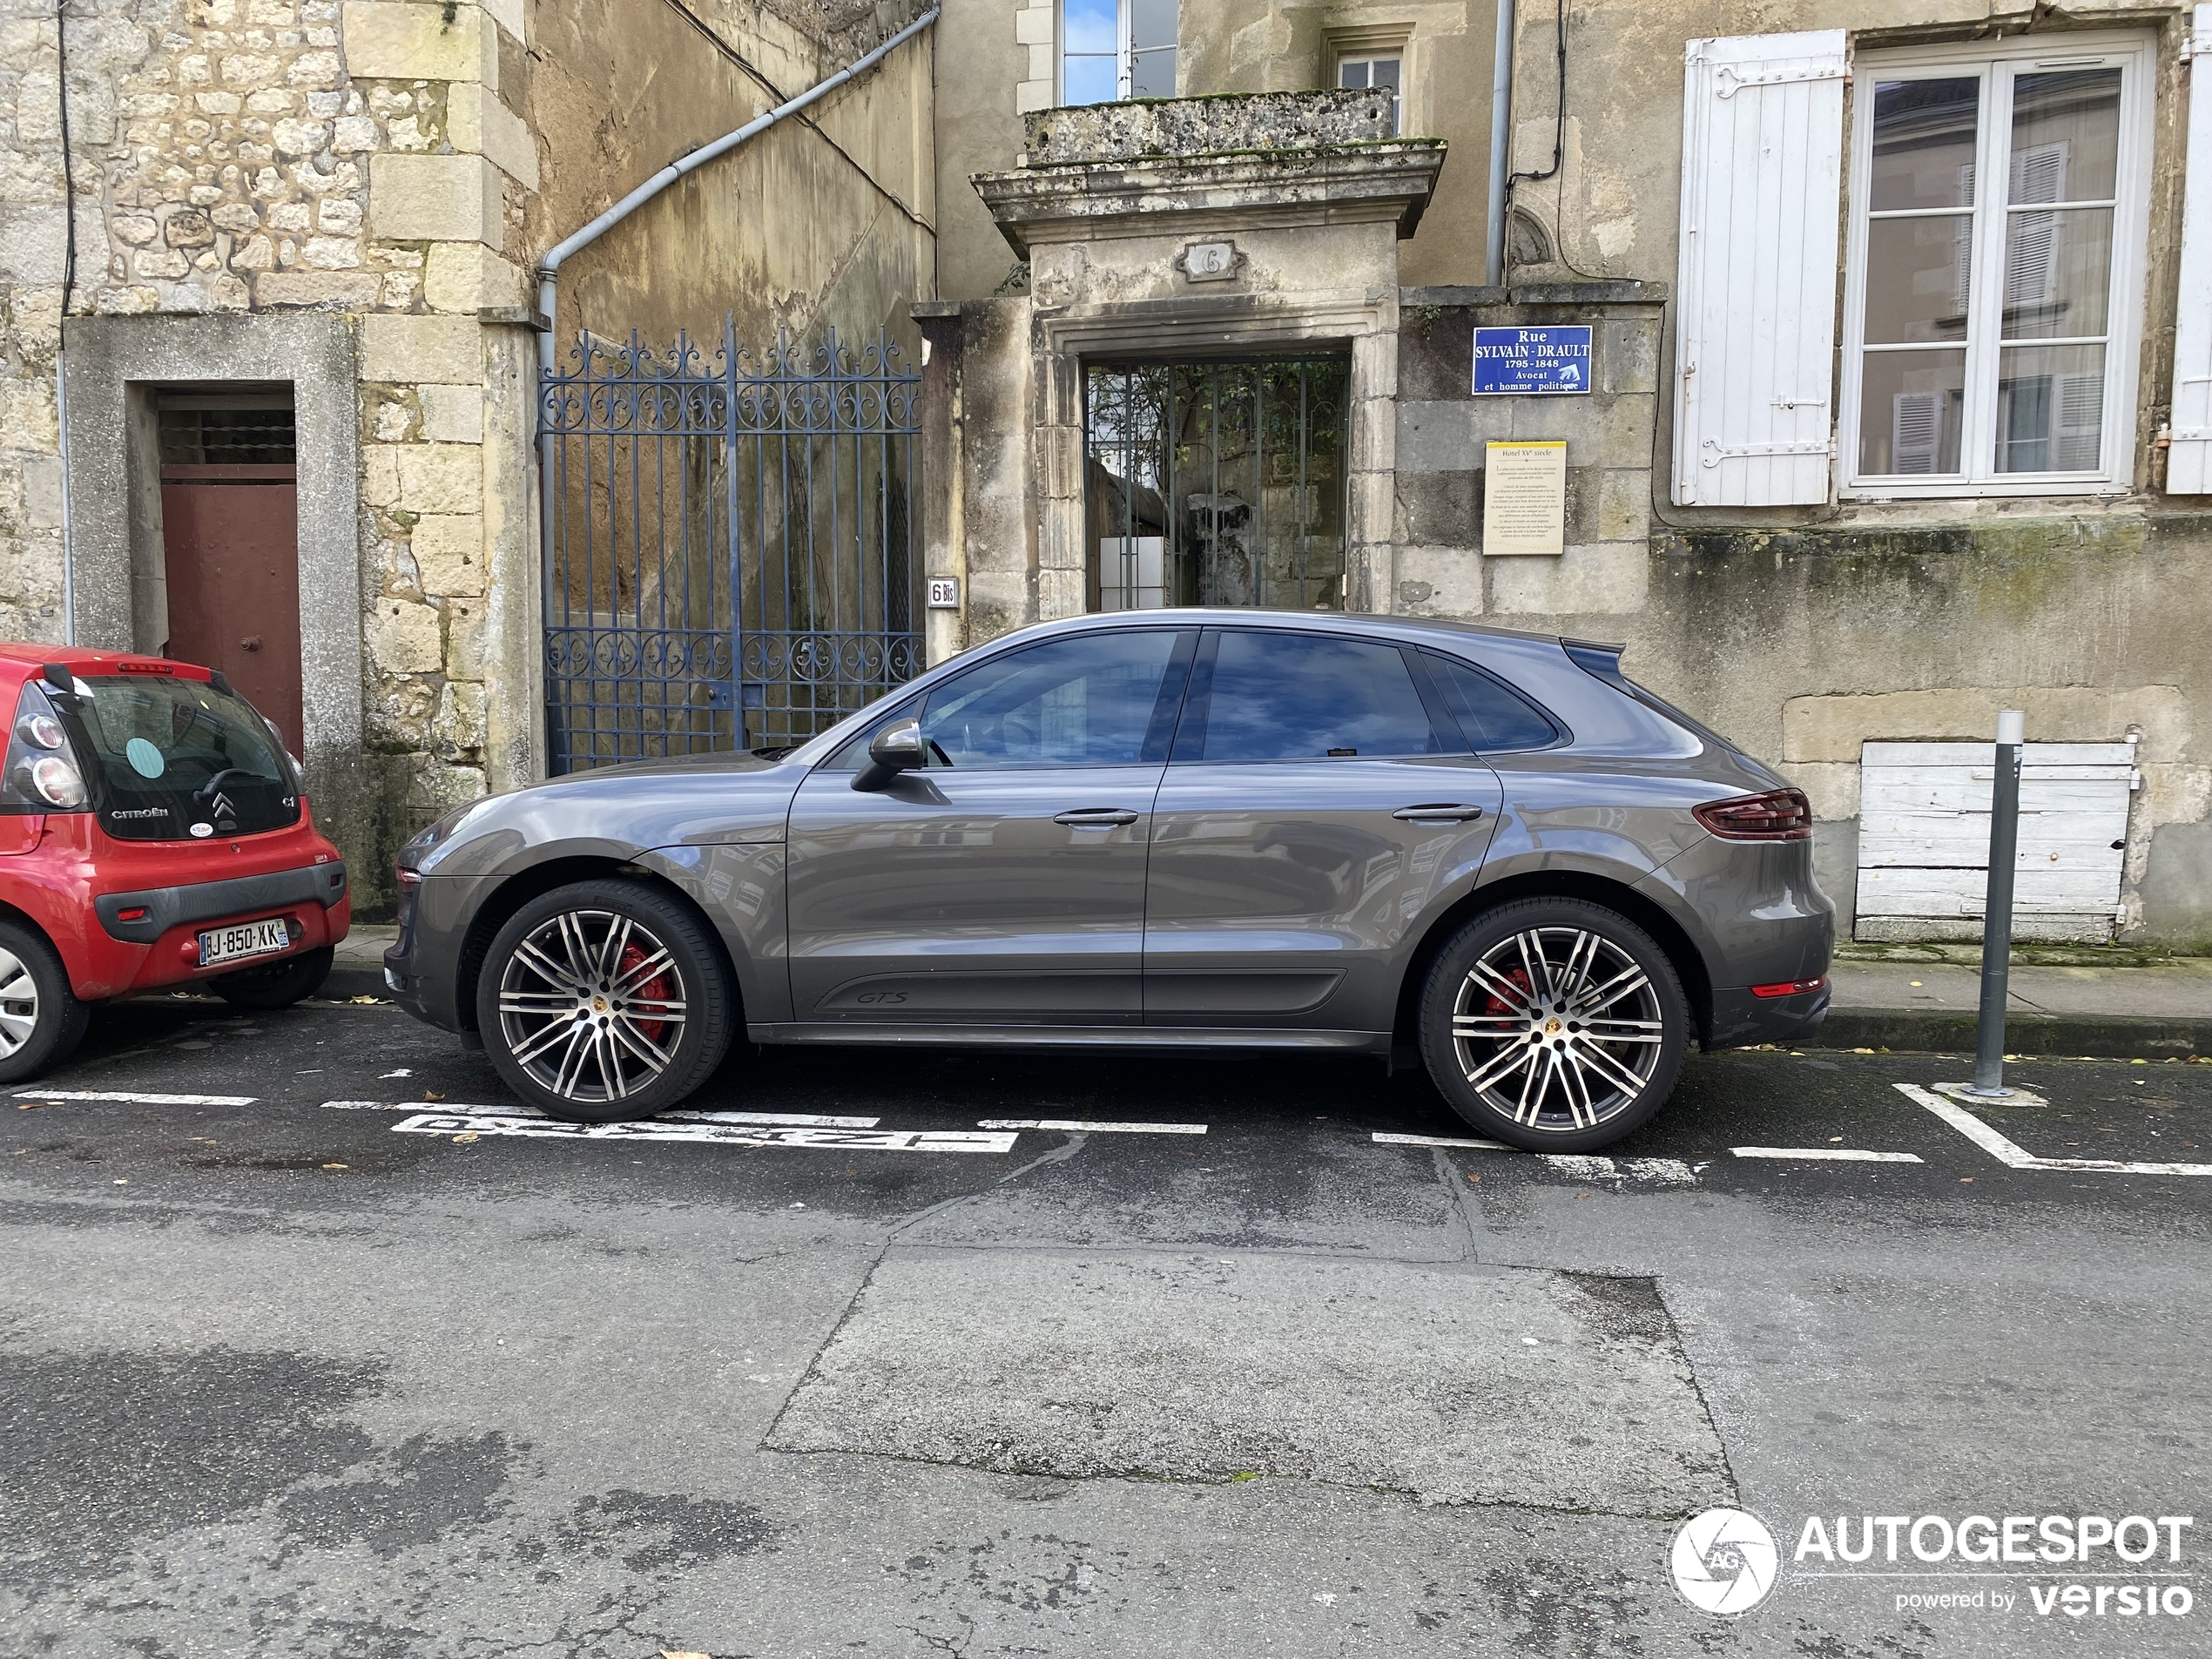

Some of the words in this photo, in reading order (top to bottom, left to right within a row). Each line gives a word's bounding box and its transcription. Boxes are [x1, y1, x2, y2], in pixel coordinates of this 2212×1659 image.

[1202, 249, 1220, 274] 6
[1518, 330, 1548, 342] Rue
[1515, 371, 1548, 380] Avocat
[1499, 381, 1533, 391] homme
[932, 583, 941, 602] 6
[943, 583, 954, 602] Bis
[282, 797, 294, 807] C1
[111, 806, 169, 819] CITROËN
[857, 992, 909, 1003] GTS
